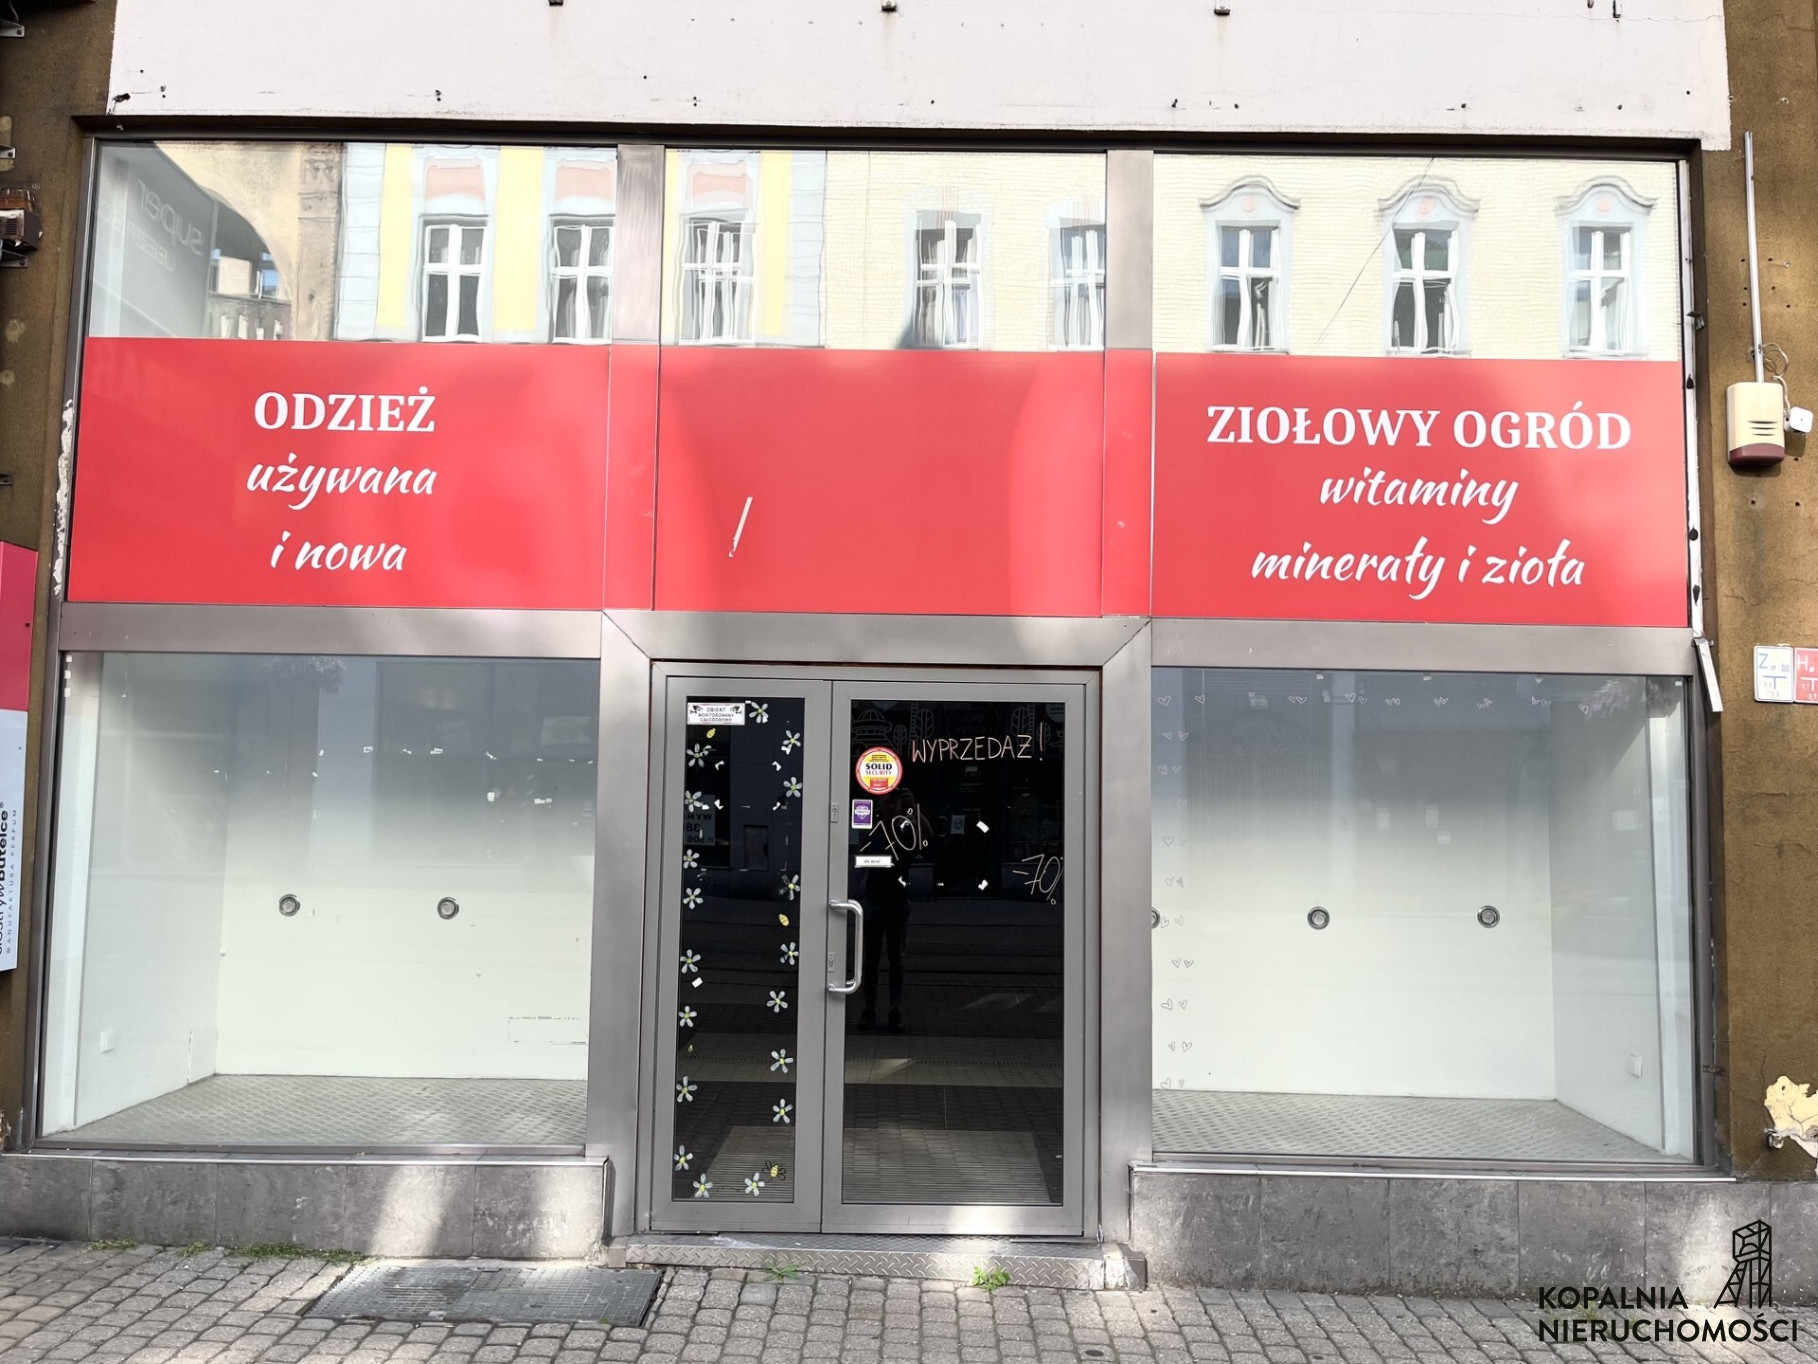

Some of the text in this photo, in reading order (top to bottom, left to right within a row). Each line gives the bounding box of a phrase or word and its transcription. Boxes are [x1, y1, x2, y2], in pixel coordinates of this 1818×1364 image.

[255, 386, 436, 432] ODZIEŻ
[1206, 400, 1632, 450] ZIOŁOWY OGRÓD
[246, 453, 438, 511] używana
[1319, 467, 1519, 525] witaminy
[270, 530, 408, 571] i nowa
[1251, 536, 1585, 601] minerały i zioła
[865, 762, 893, 770] SOLID
